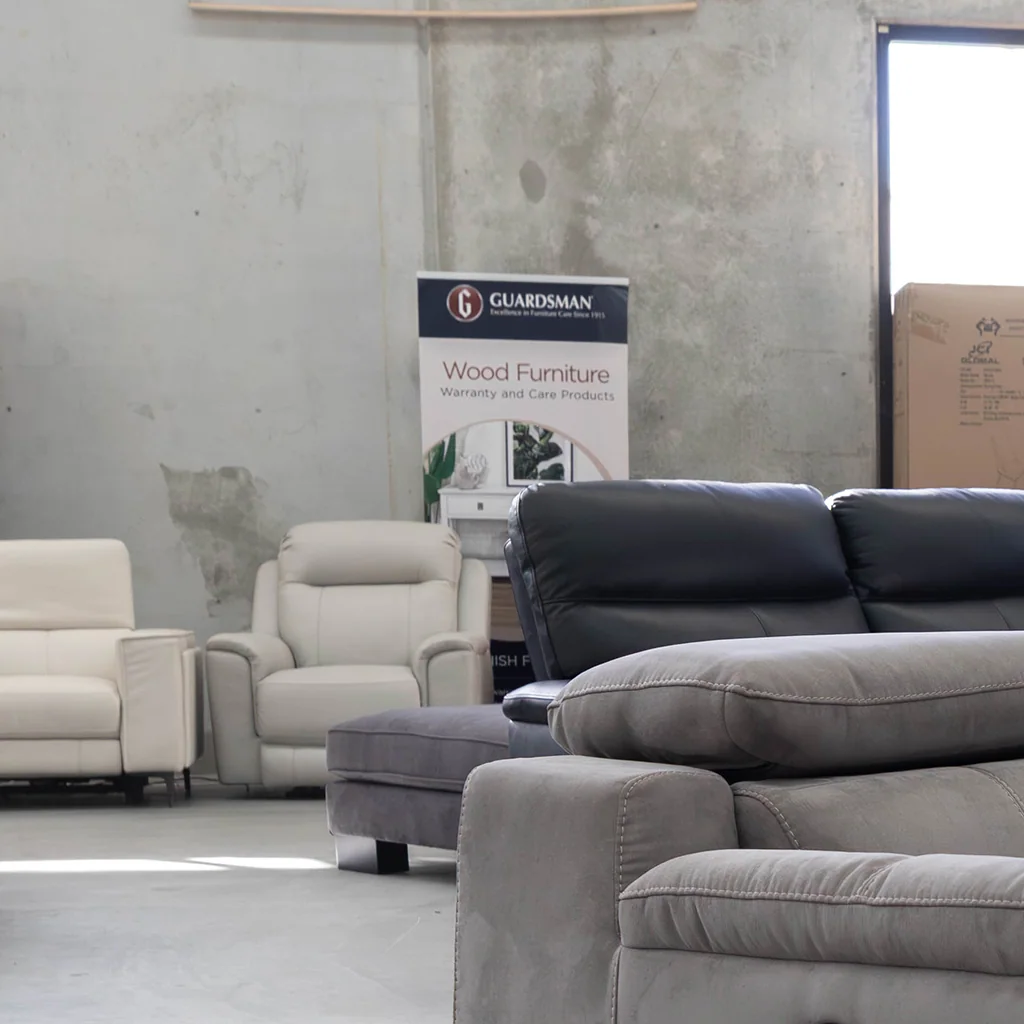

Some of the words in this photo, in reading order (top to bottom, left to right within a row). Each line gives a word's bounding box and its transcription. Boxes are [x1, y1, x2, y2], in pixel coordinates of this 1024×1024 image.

[489, 292, 592, 310] GUARDSMAN
[490, 308, 522, 316] Excellence
[530, 309, 557, 317] Furniture
[558, 310, 572, 318] Care
[442, 361, 509, 381] Wood
[516, 363, 610, 384] Furniture
[440, 387, 497, 400] Warranty
[501, 388, 524, 399] and
[528, 389, 557, 400] Care
[561, 389, 615, 402] Products
[491, 655, 517, 667] ISH
